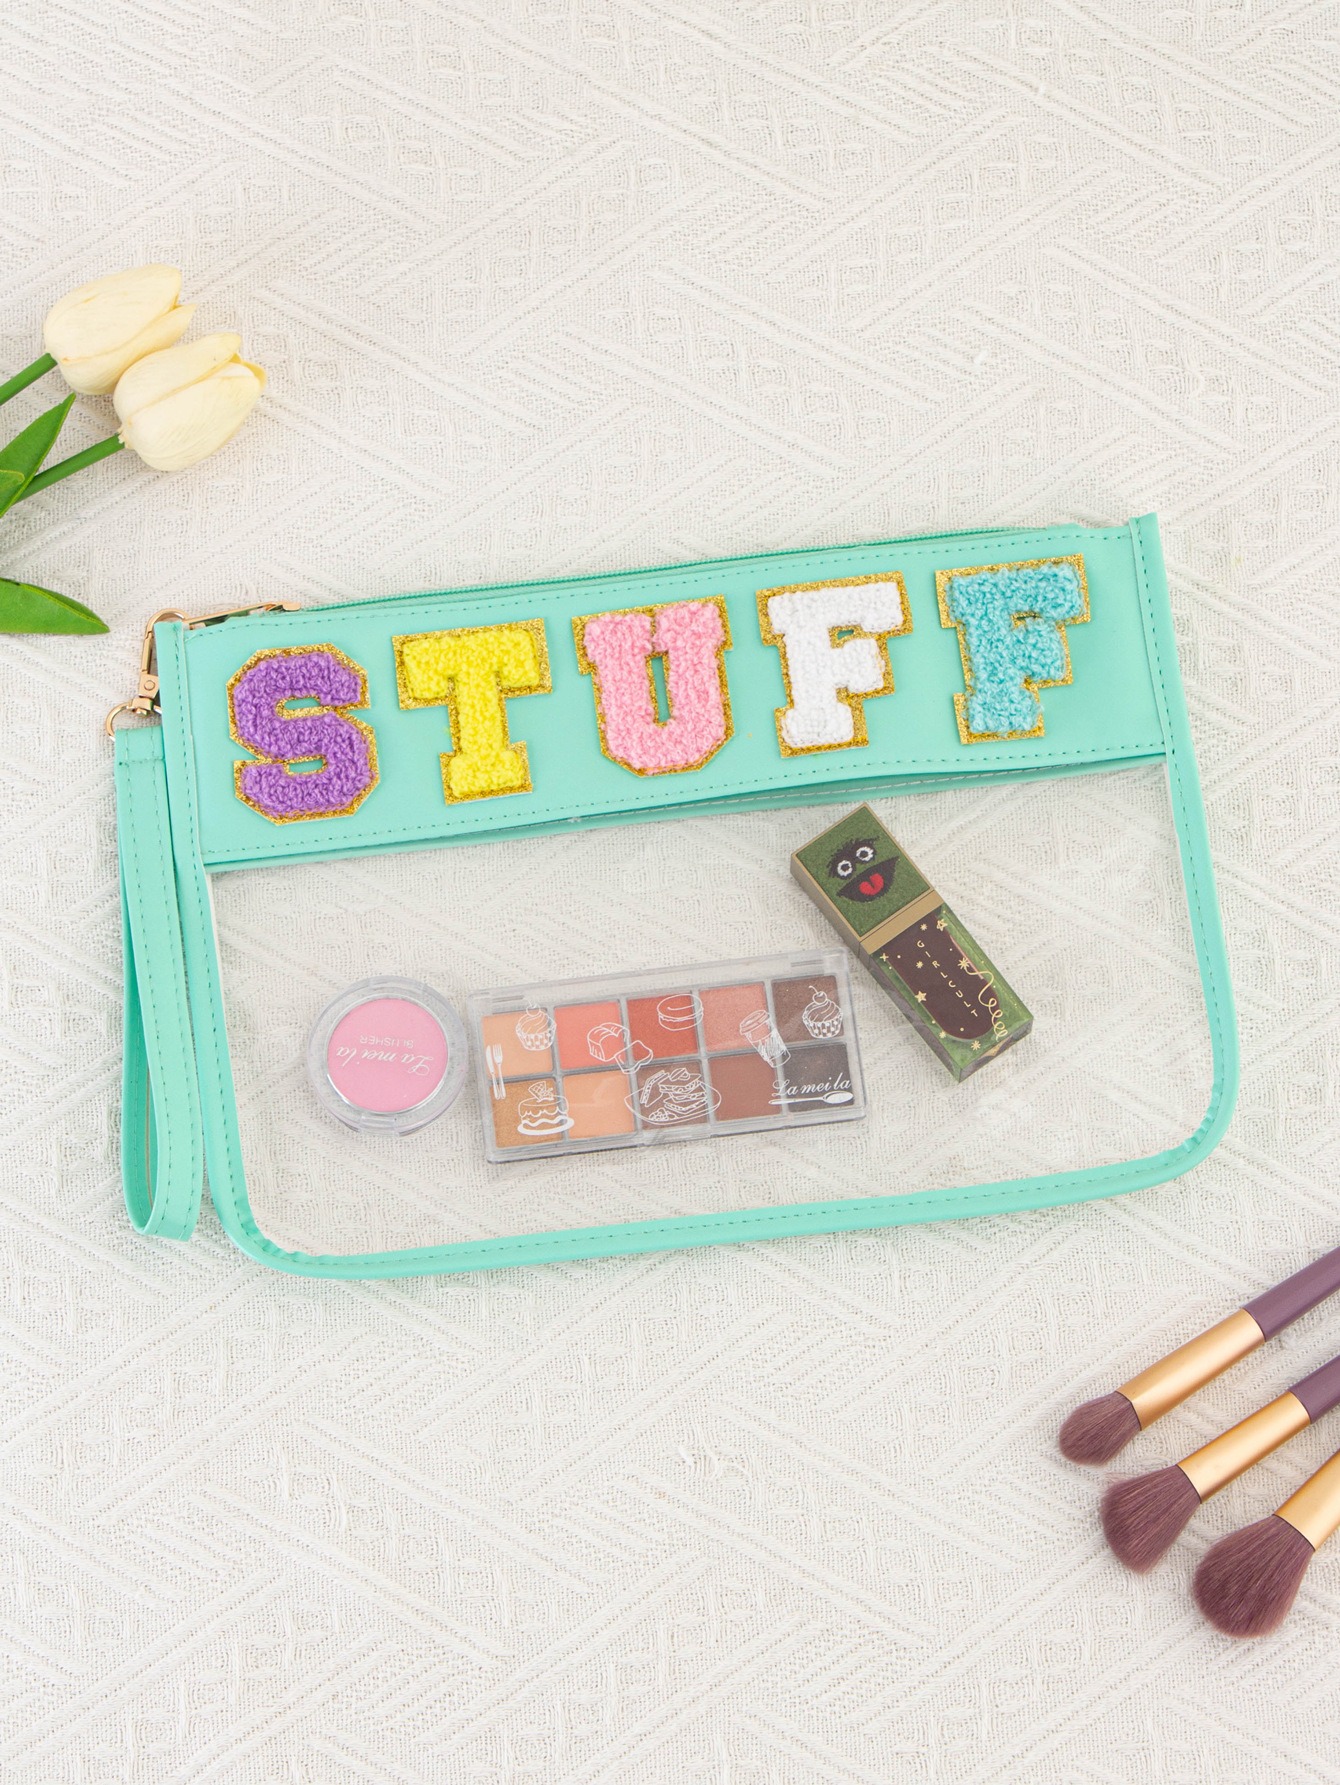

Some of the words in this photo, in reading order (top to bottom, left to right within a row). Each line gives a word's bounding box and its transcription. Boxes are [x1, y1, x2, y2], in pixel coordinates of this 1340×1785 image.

[228, 553, 1090, 825] STUFF
[916, 940, 978, 1017] GIRLCULT
[336, 1046, 356, 1067] la
[357, 1046, 397, 1064] mei
[402, 1053, 434, 1076] La
[773, 1080, 799, 1097] La
[800, 1076, 832, 1094] mei
[833, 1072, 852, 1090] la
